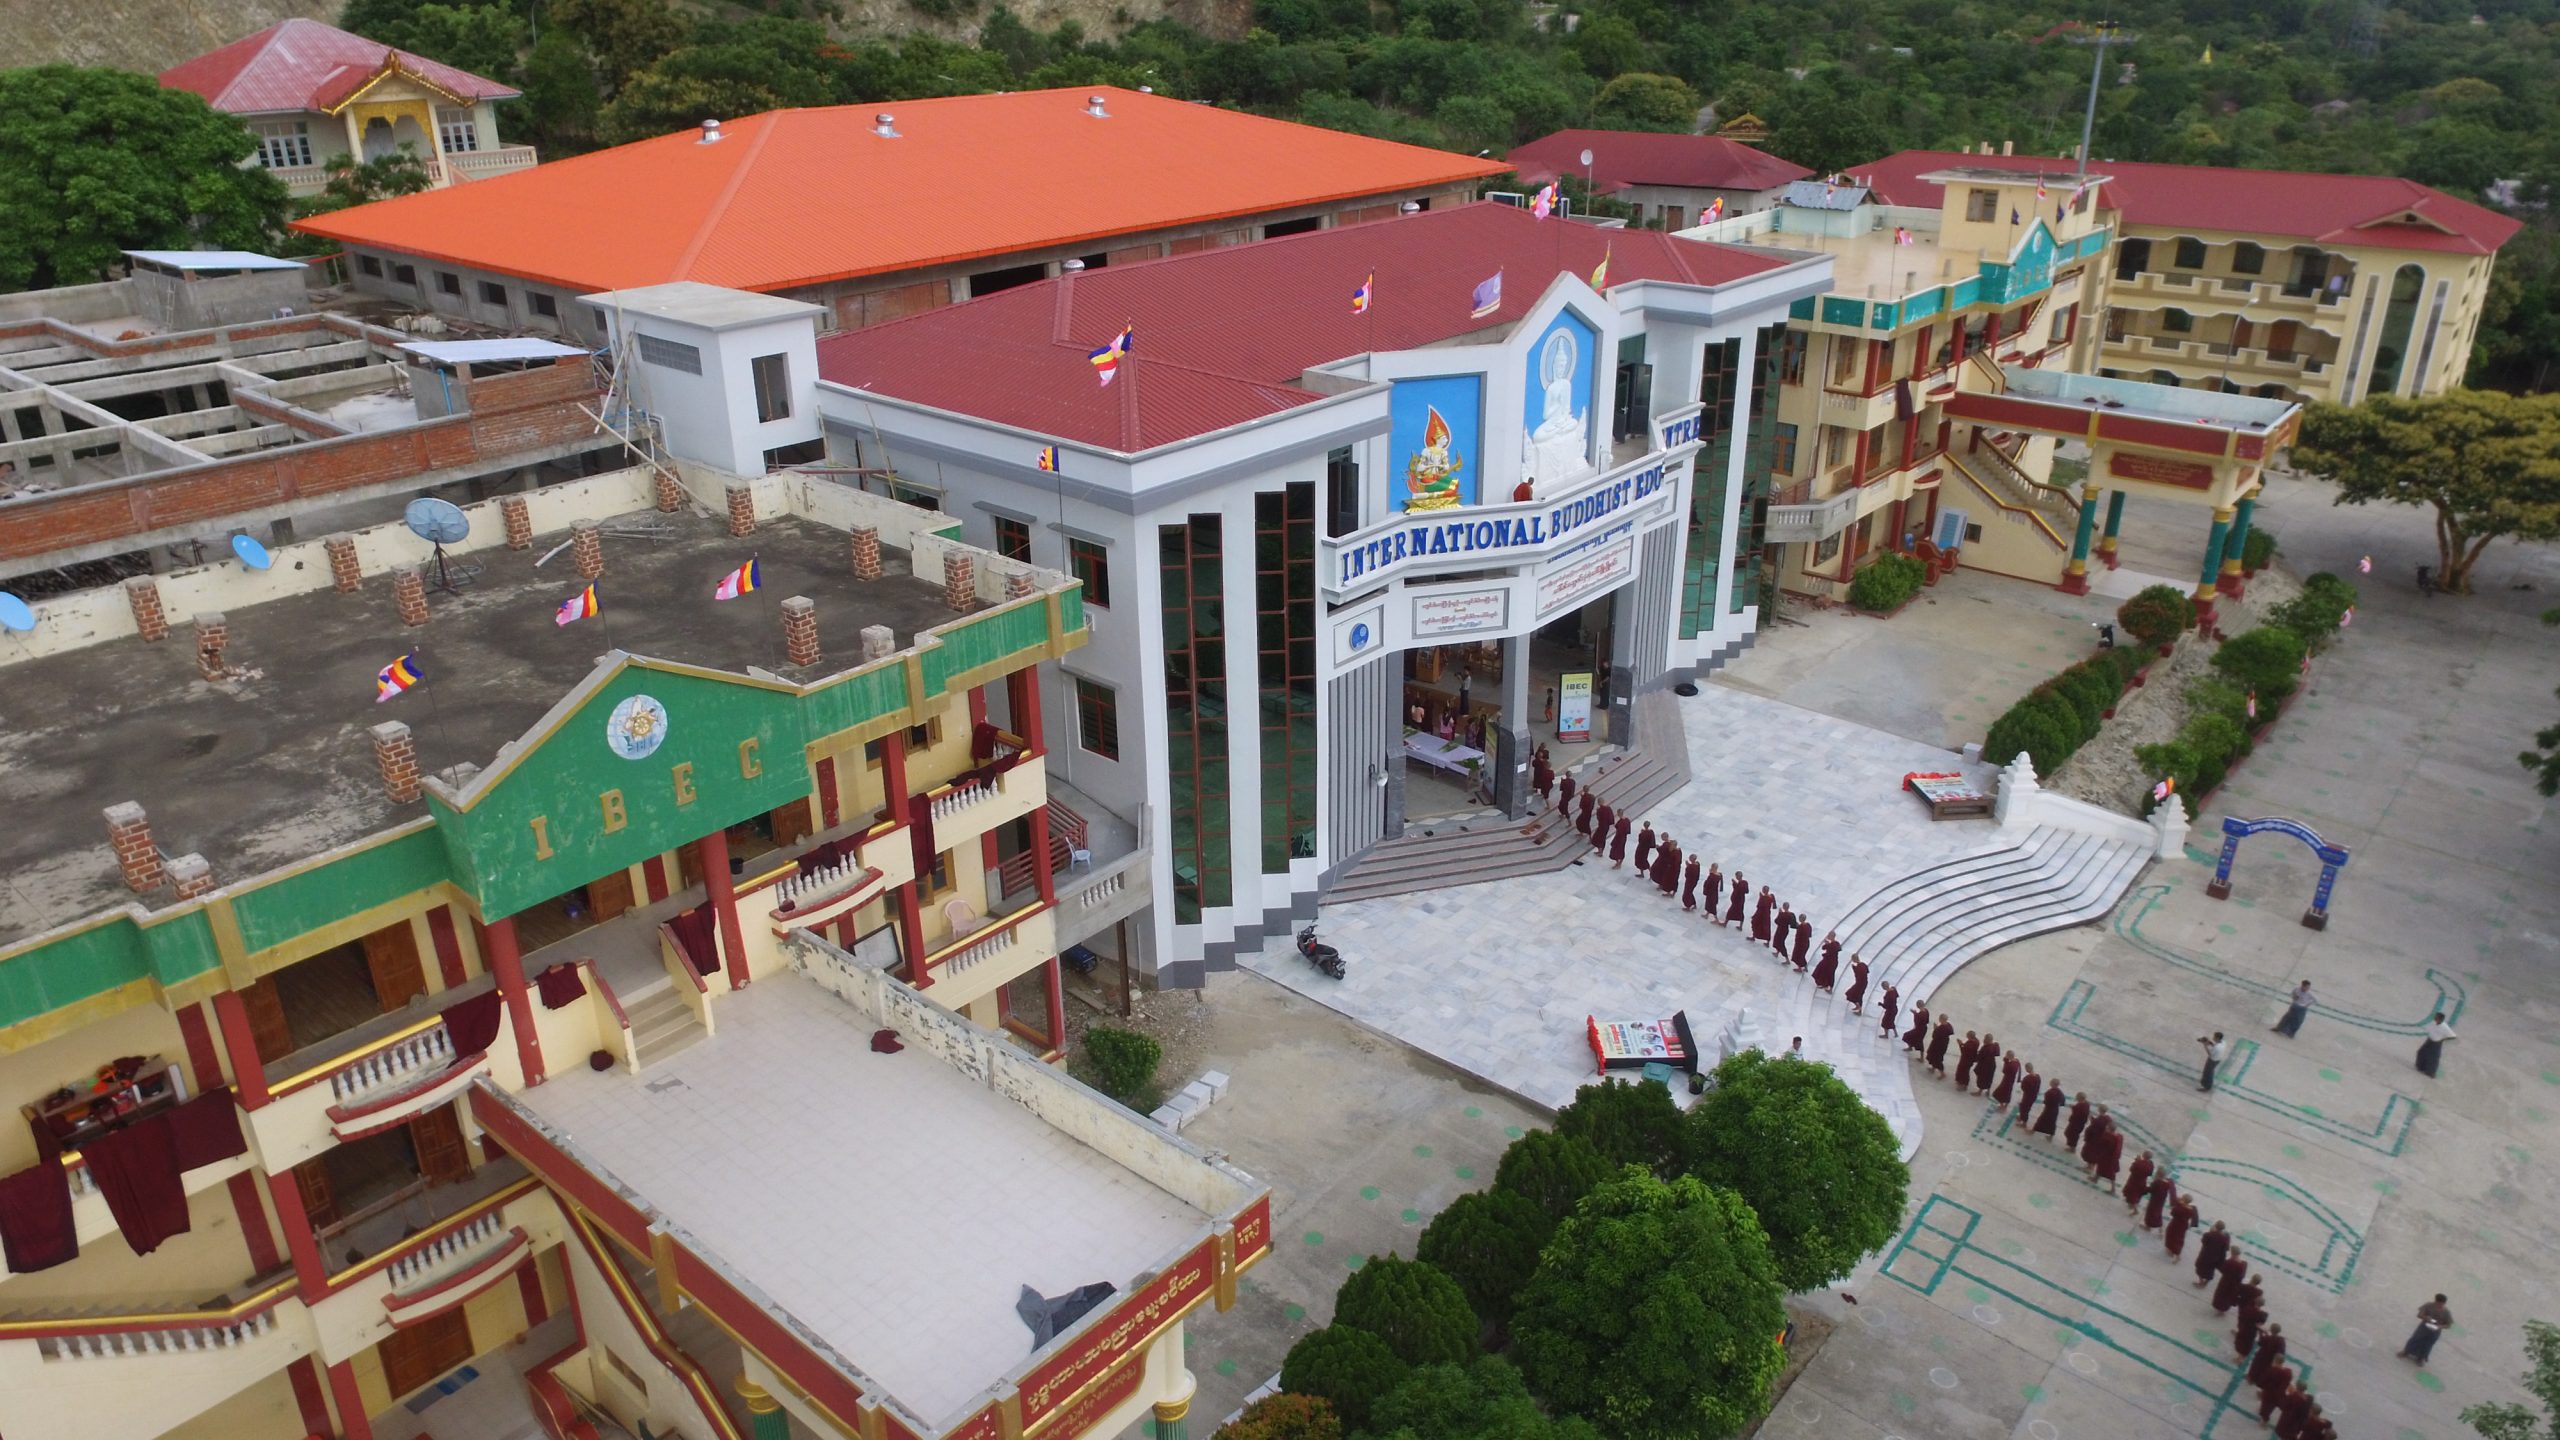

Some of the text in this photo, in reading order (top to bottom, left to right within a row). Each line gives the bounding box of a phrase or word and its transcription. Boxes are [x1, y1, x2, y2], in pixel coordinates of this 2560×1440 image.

[1342, 516, 1546, 582] INTERNATIONAL
[1551, 478, 1632, 539] BUDDHIST
[1565, 682, 1588, 690] IBEC
[530, 737, 762, 861] IBEC
